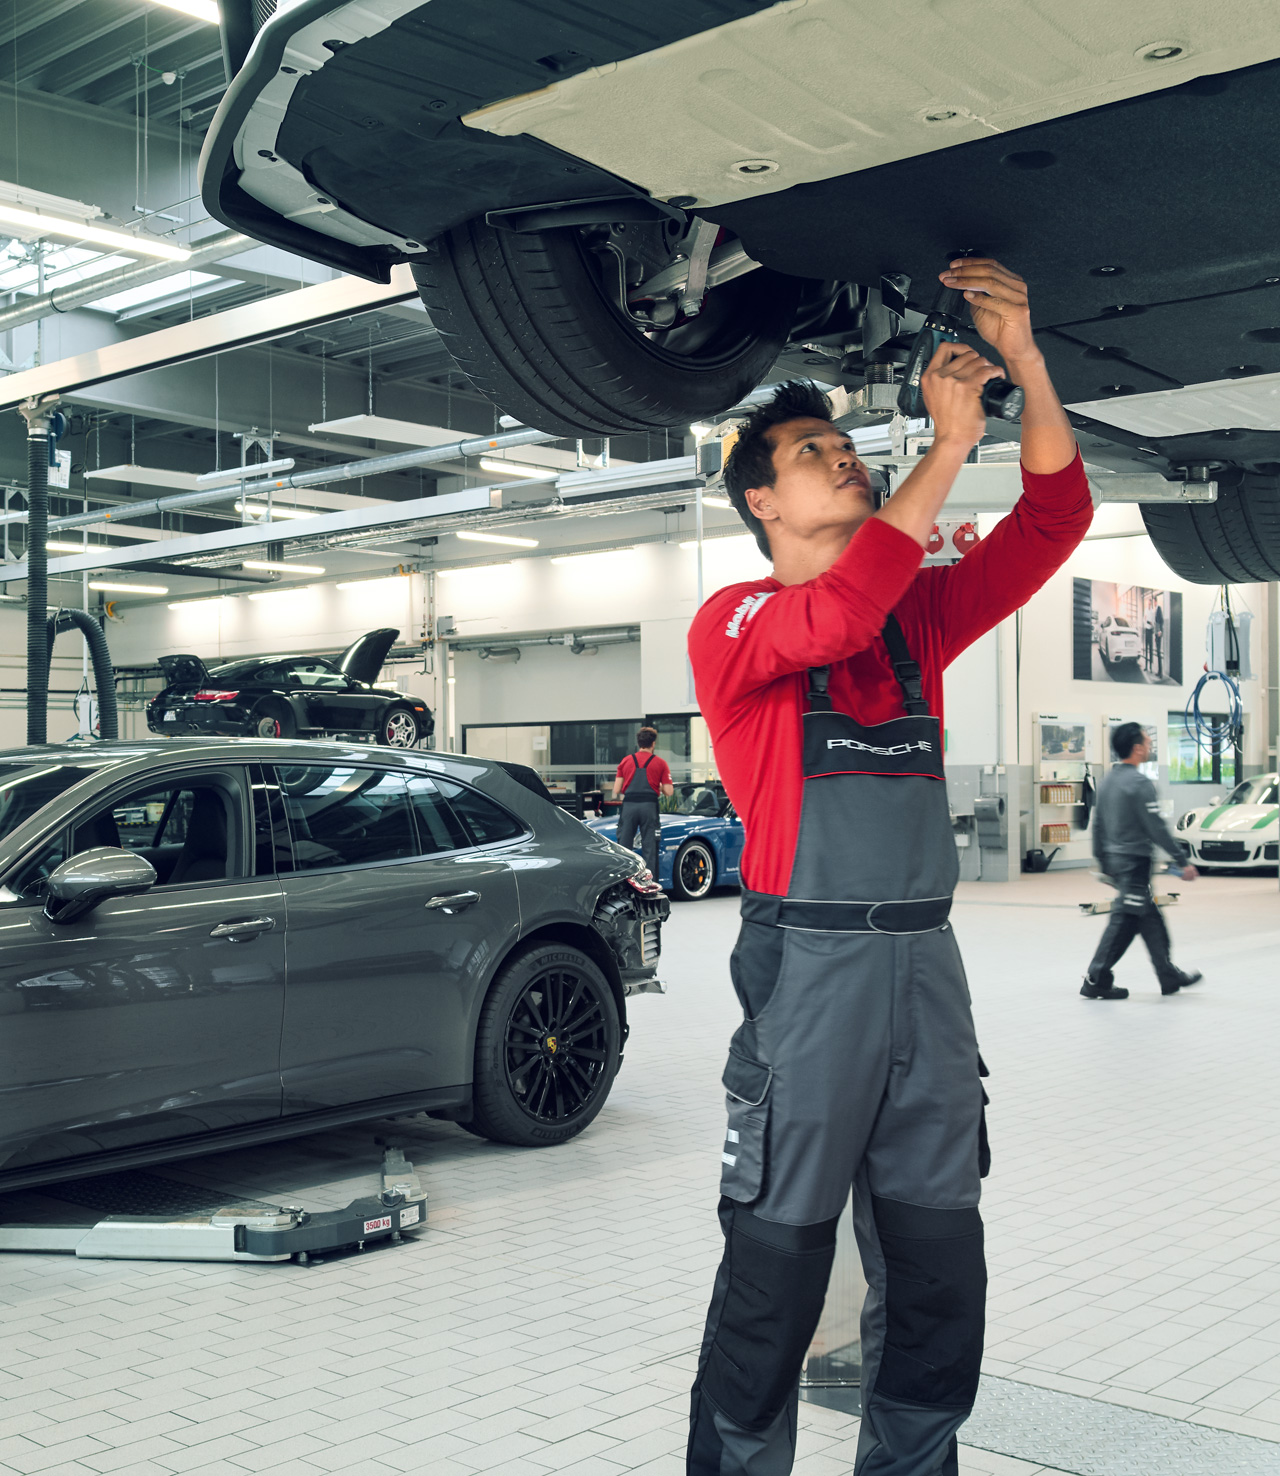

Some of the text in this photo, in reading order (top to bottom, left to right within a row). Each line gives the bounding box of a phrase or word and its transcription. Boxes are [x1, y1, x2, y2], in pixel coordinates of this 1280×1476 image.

[826, 738, 933, 756] PORSCHE
[540, 952, 584, 965] MICHELIN
[365, 1218, 390, 1231] 3500 kg
